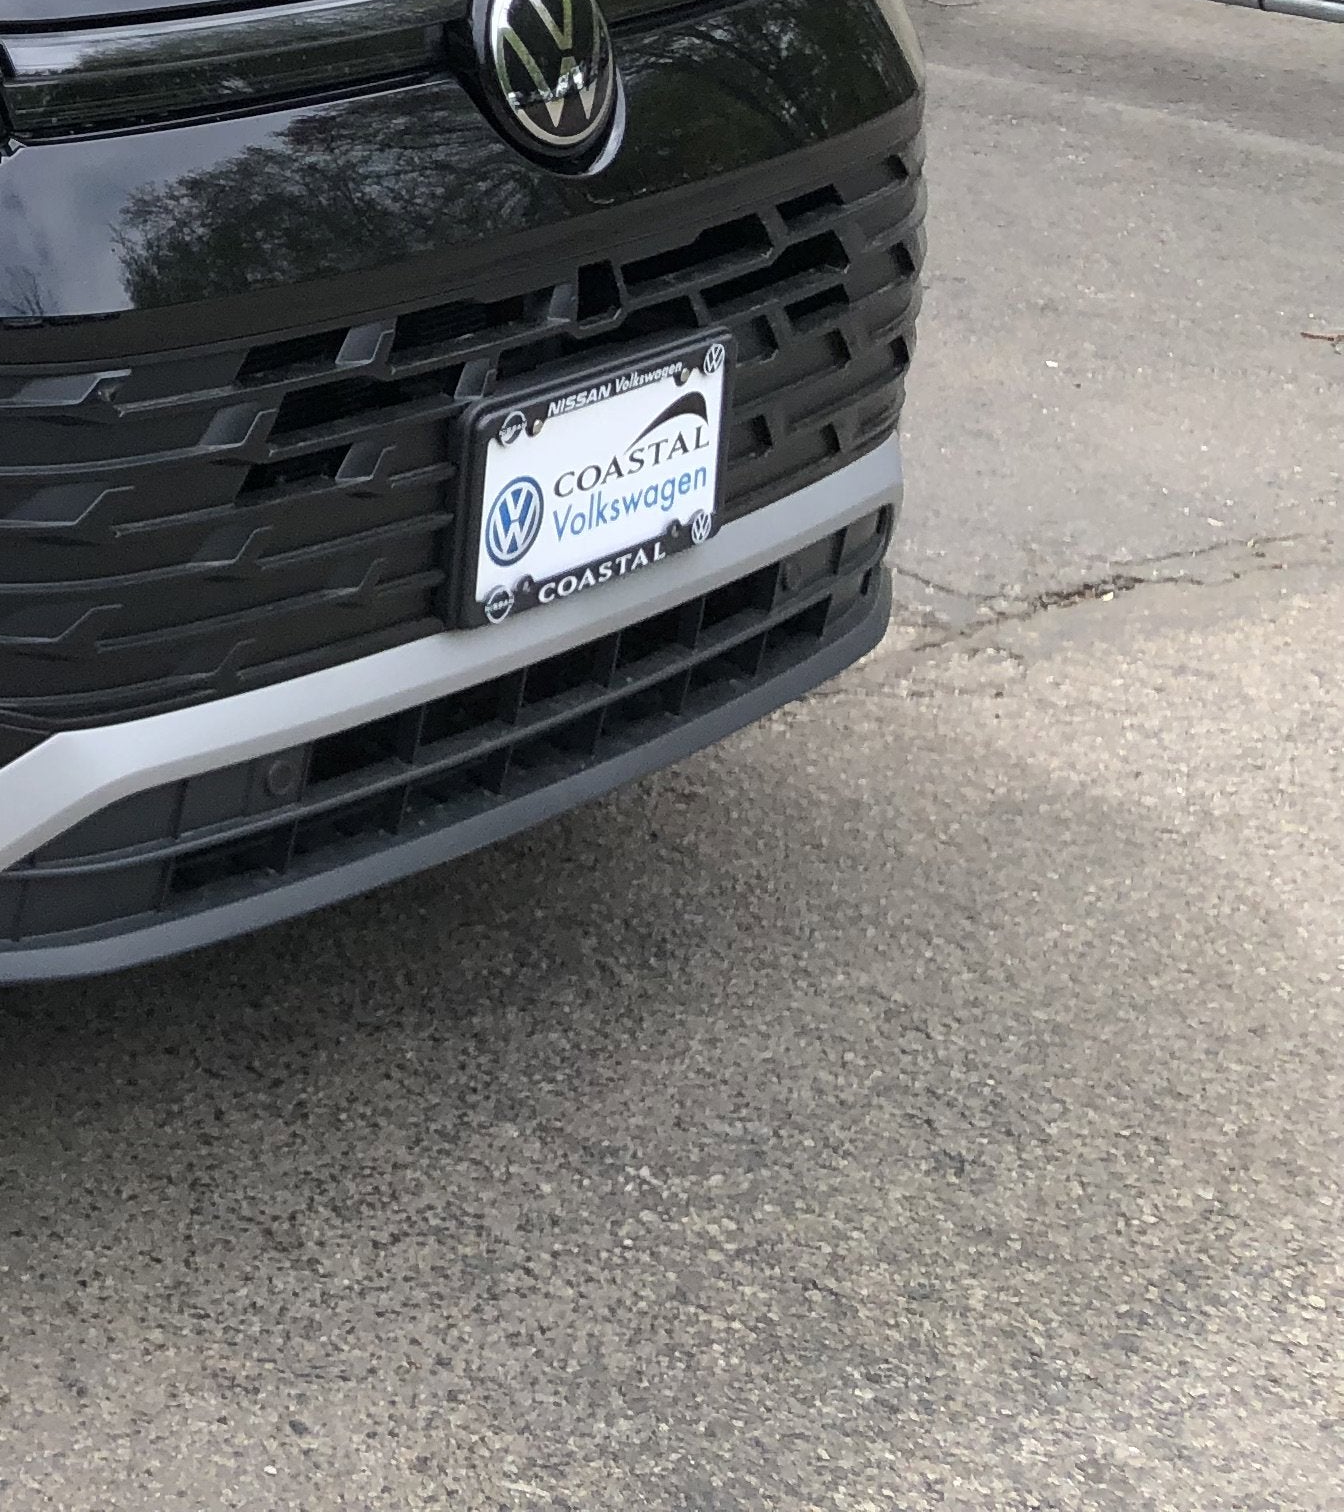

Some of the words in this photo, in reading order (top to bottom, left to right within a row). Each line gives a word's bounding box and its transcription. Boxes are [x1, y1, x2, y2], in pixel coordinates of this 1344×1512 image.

[547, 382, 611, 418] NISSAN
[615, 361, 683, 392] Volkswagen
[553, 425, 710, 498] COASTAL
[552, 466, 707, 541] Volkswagen
[538, 541, 666, 603] COASTAL
